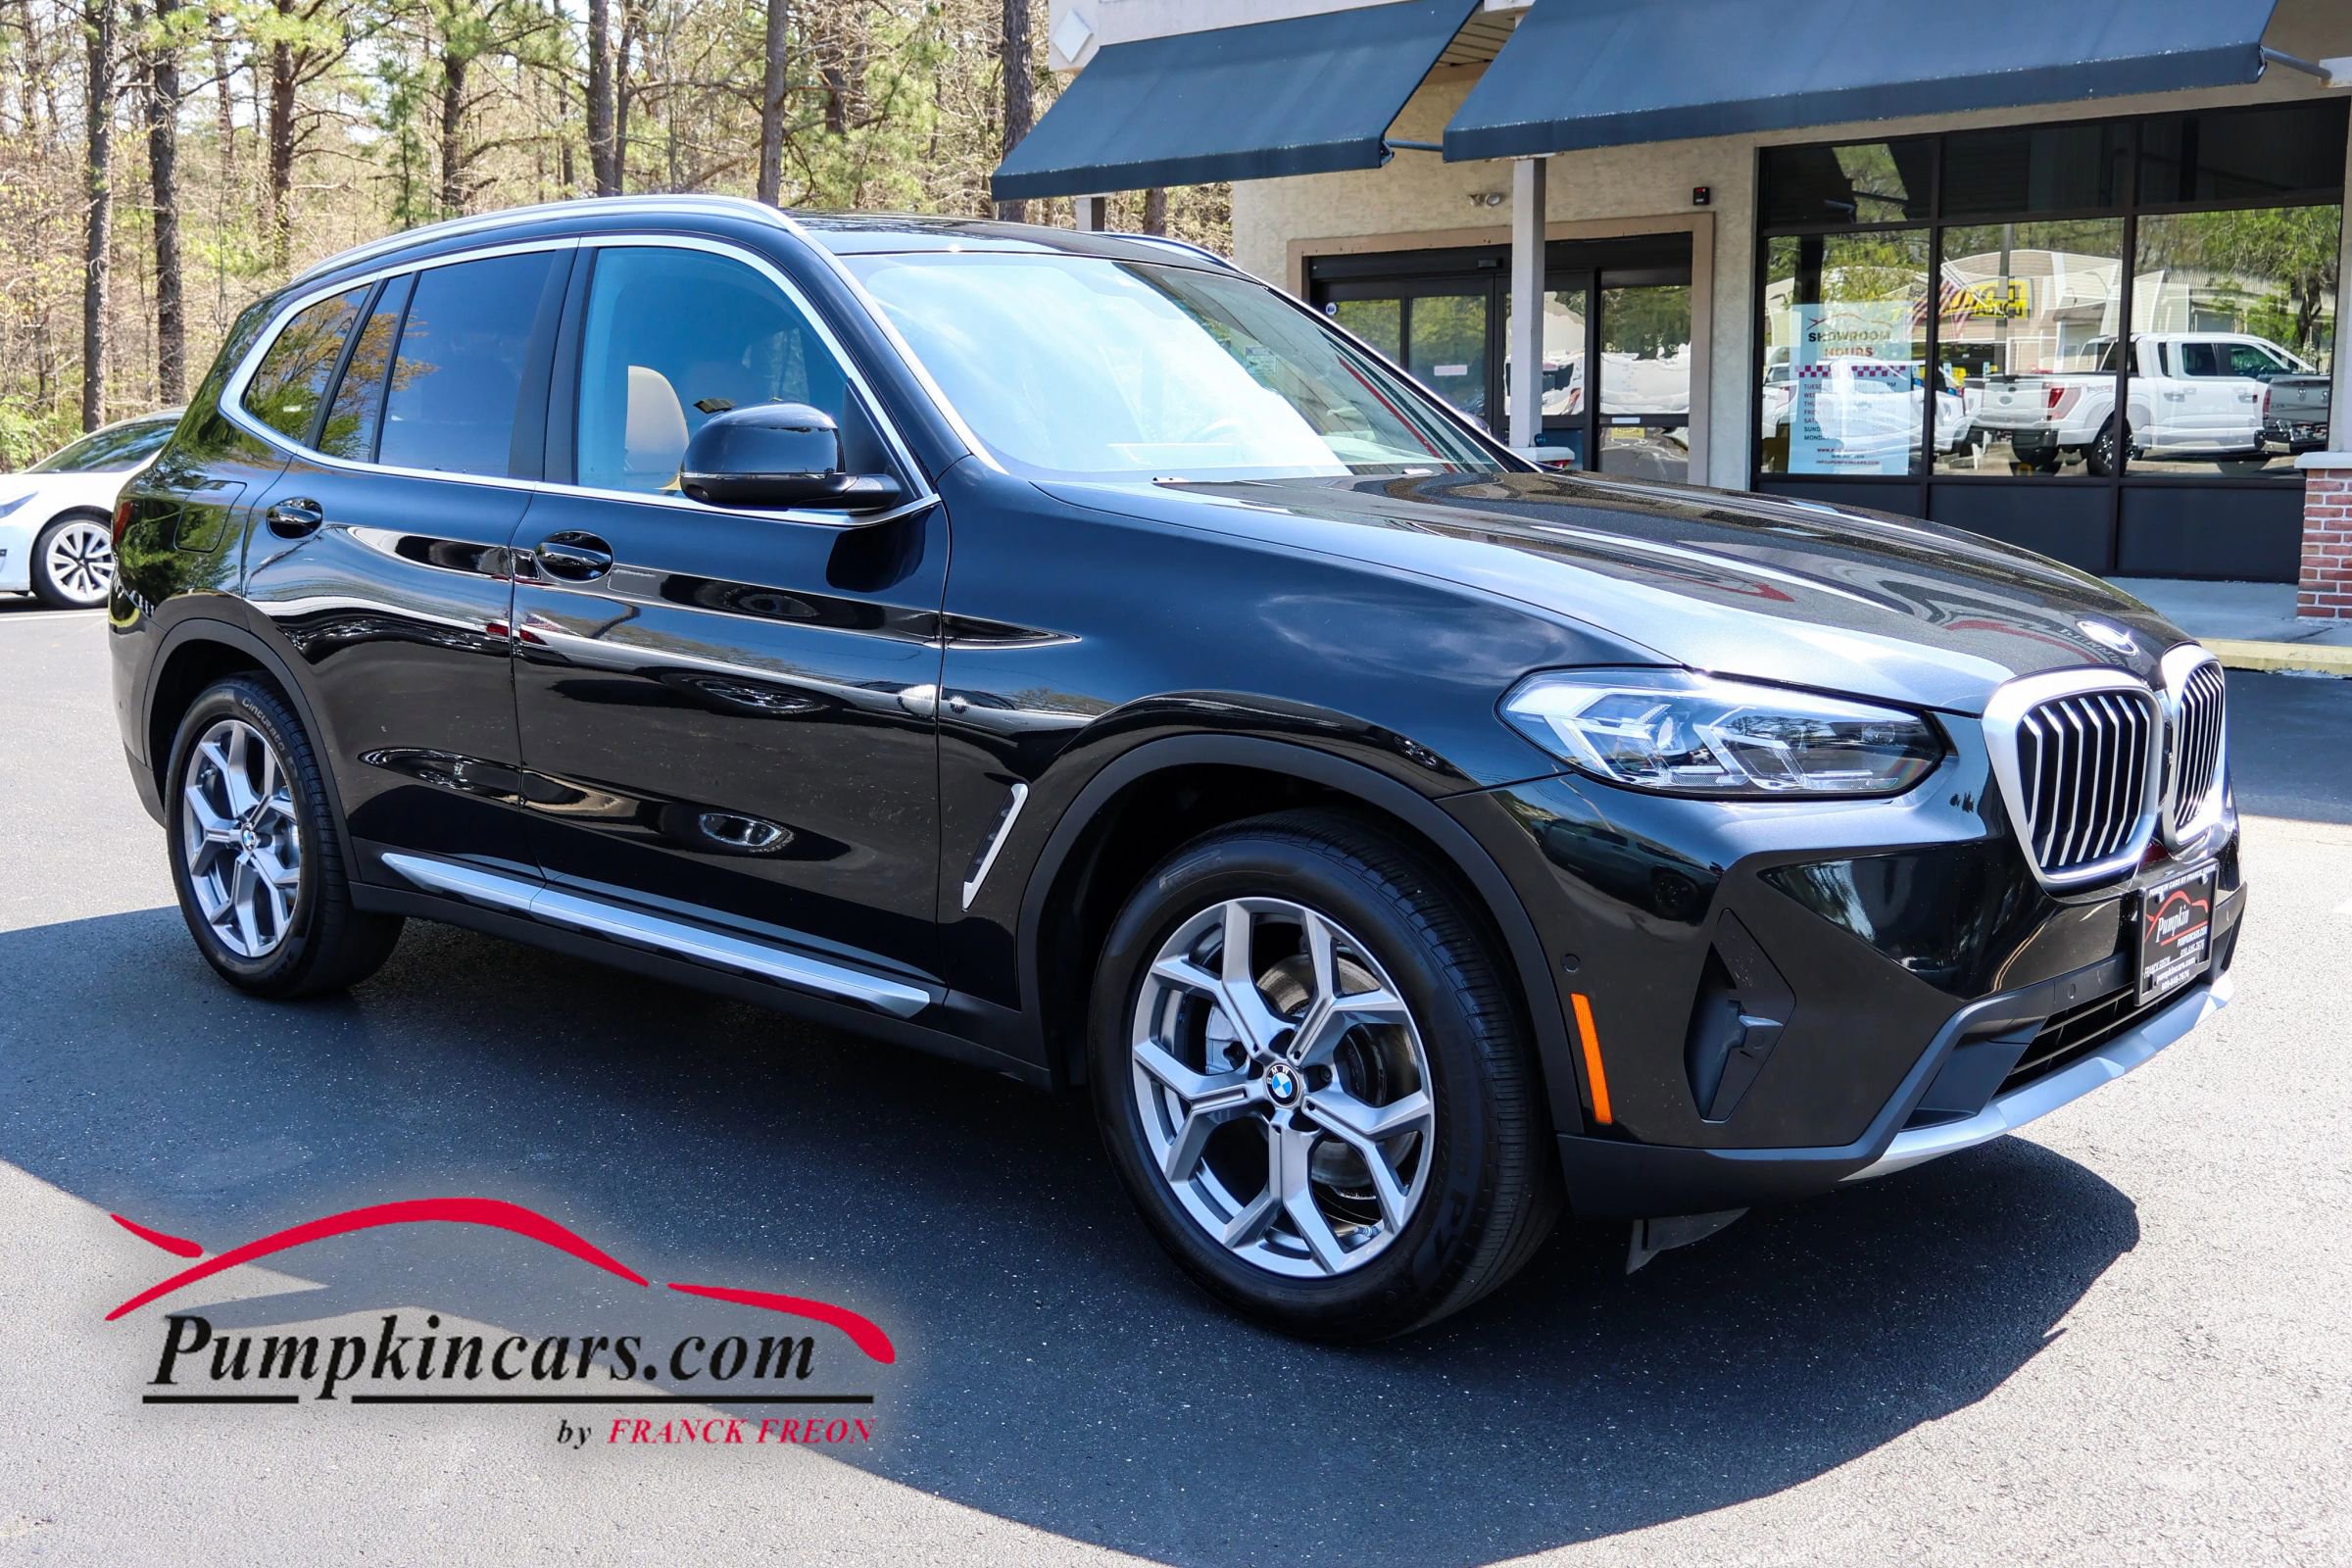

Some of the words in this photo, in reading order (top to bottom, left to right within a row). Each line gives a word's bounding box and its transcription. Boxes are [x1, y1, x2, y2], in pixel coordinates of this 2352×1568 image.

[1808, 330, 1890, 342] SHOWROOM
[1824, 347, 1874, 358] HOURS
[241, 697, 286, 753] Cinturato
[2155, 906, 2189, 944] Pumpkin
